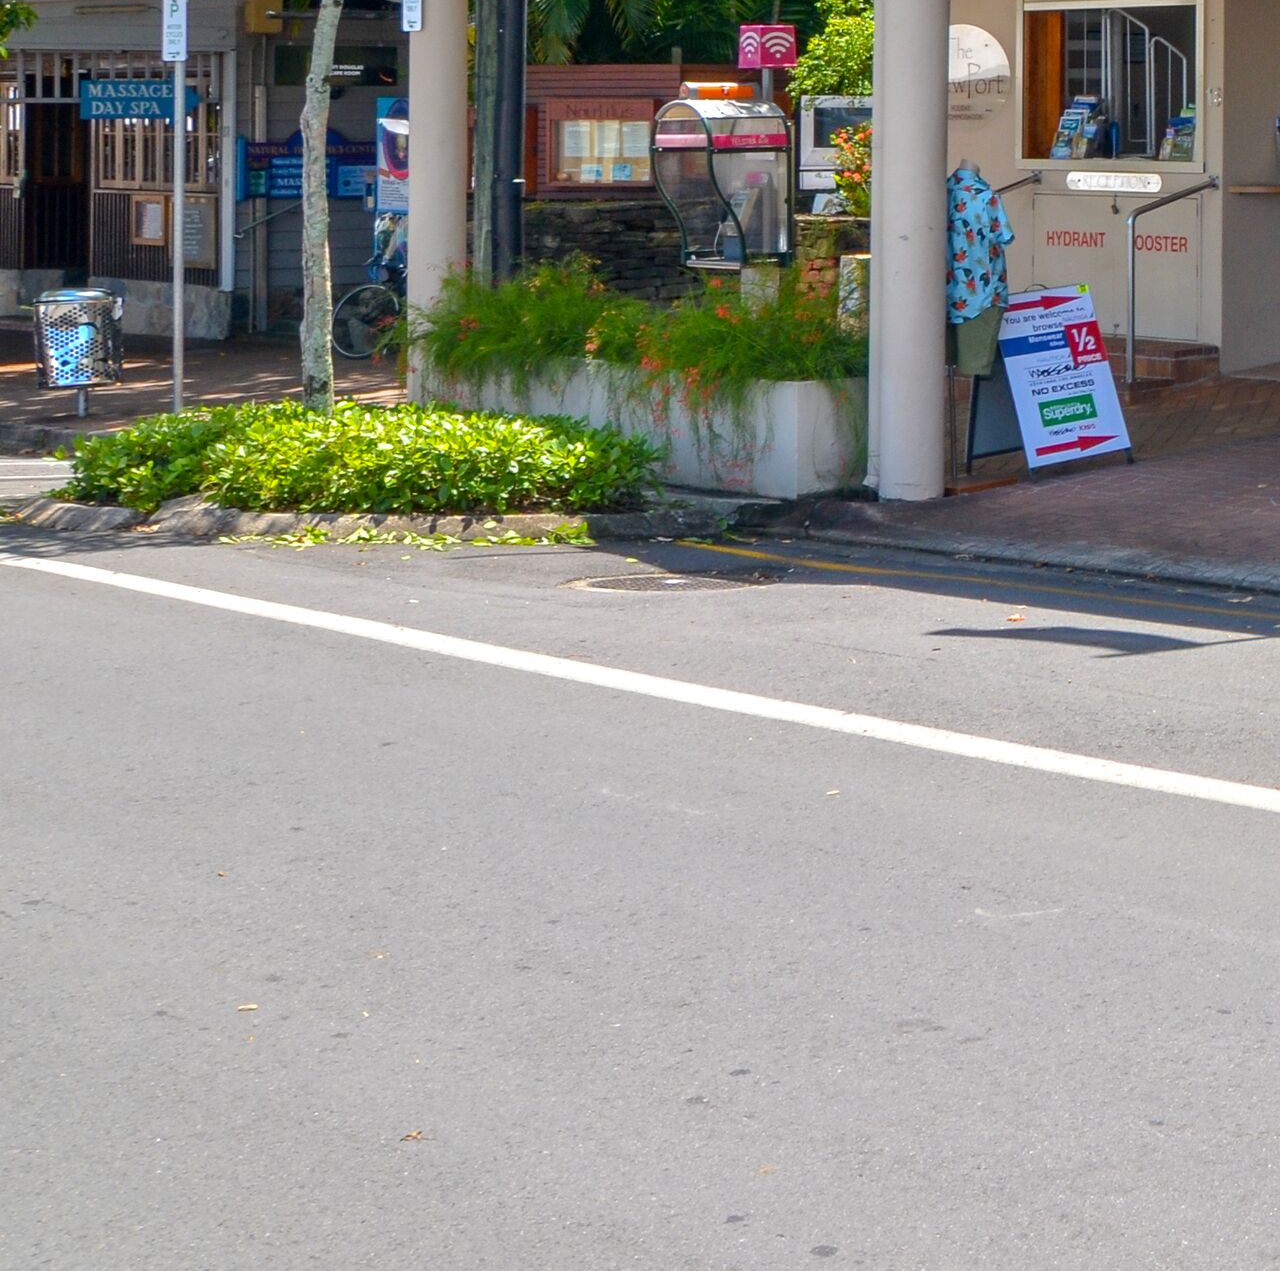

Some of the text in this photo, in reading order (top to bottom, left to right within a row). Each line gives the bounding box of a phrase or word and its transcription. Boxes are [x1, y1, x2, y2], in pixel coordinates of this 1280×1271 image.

[170, 3, 179, 18] P
[88, 84, 173, 98] MASSAGE
[91, 101, 160, 115] DAY SPA
[1046, 231, 1188, 253] HYDRANT OOSTER
[1004, 316, 1021, 325] You
[1023, 314, 1036, 322] are
[1032, 322, 1064, 333] browse
[1032, 387, 1050, 396] NO
[1051, 379, 1095, 392] EXCESS
